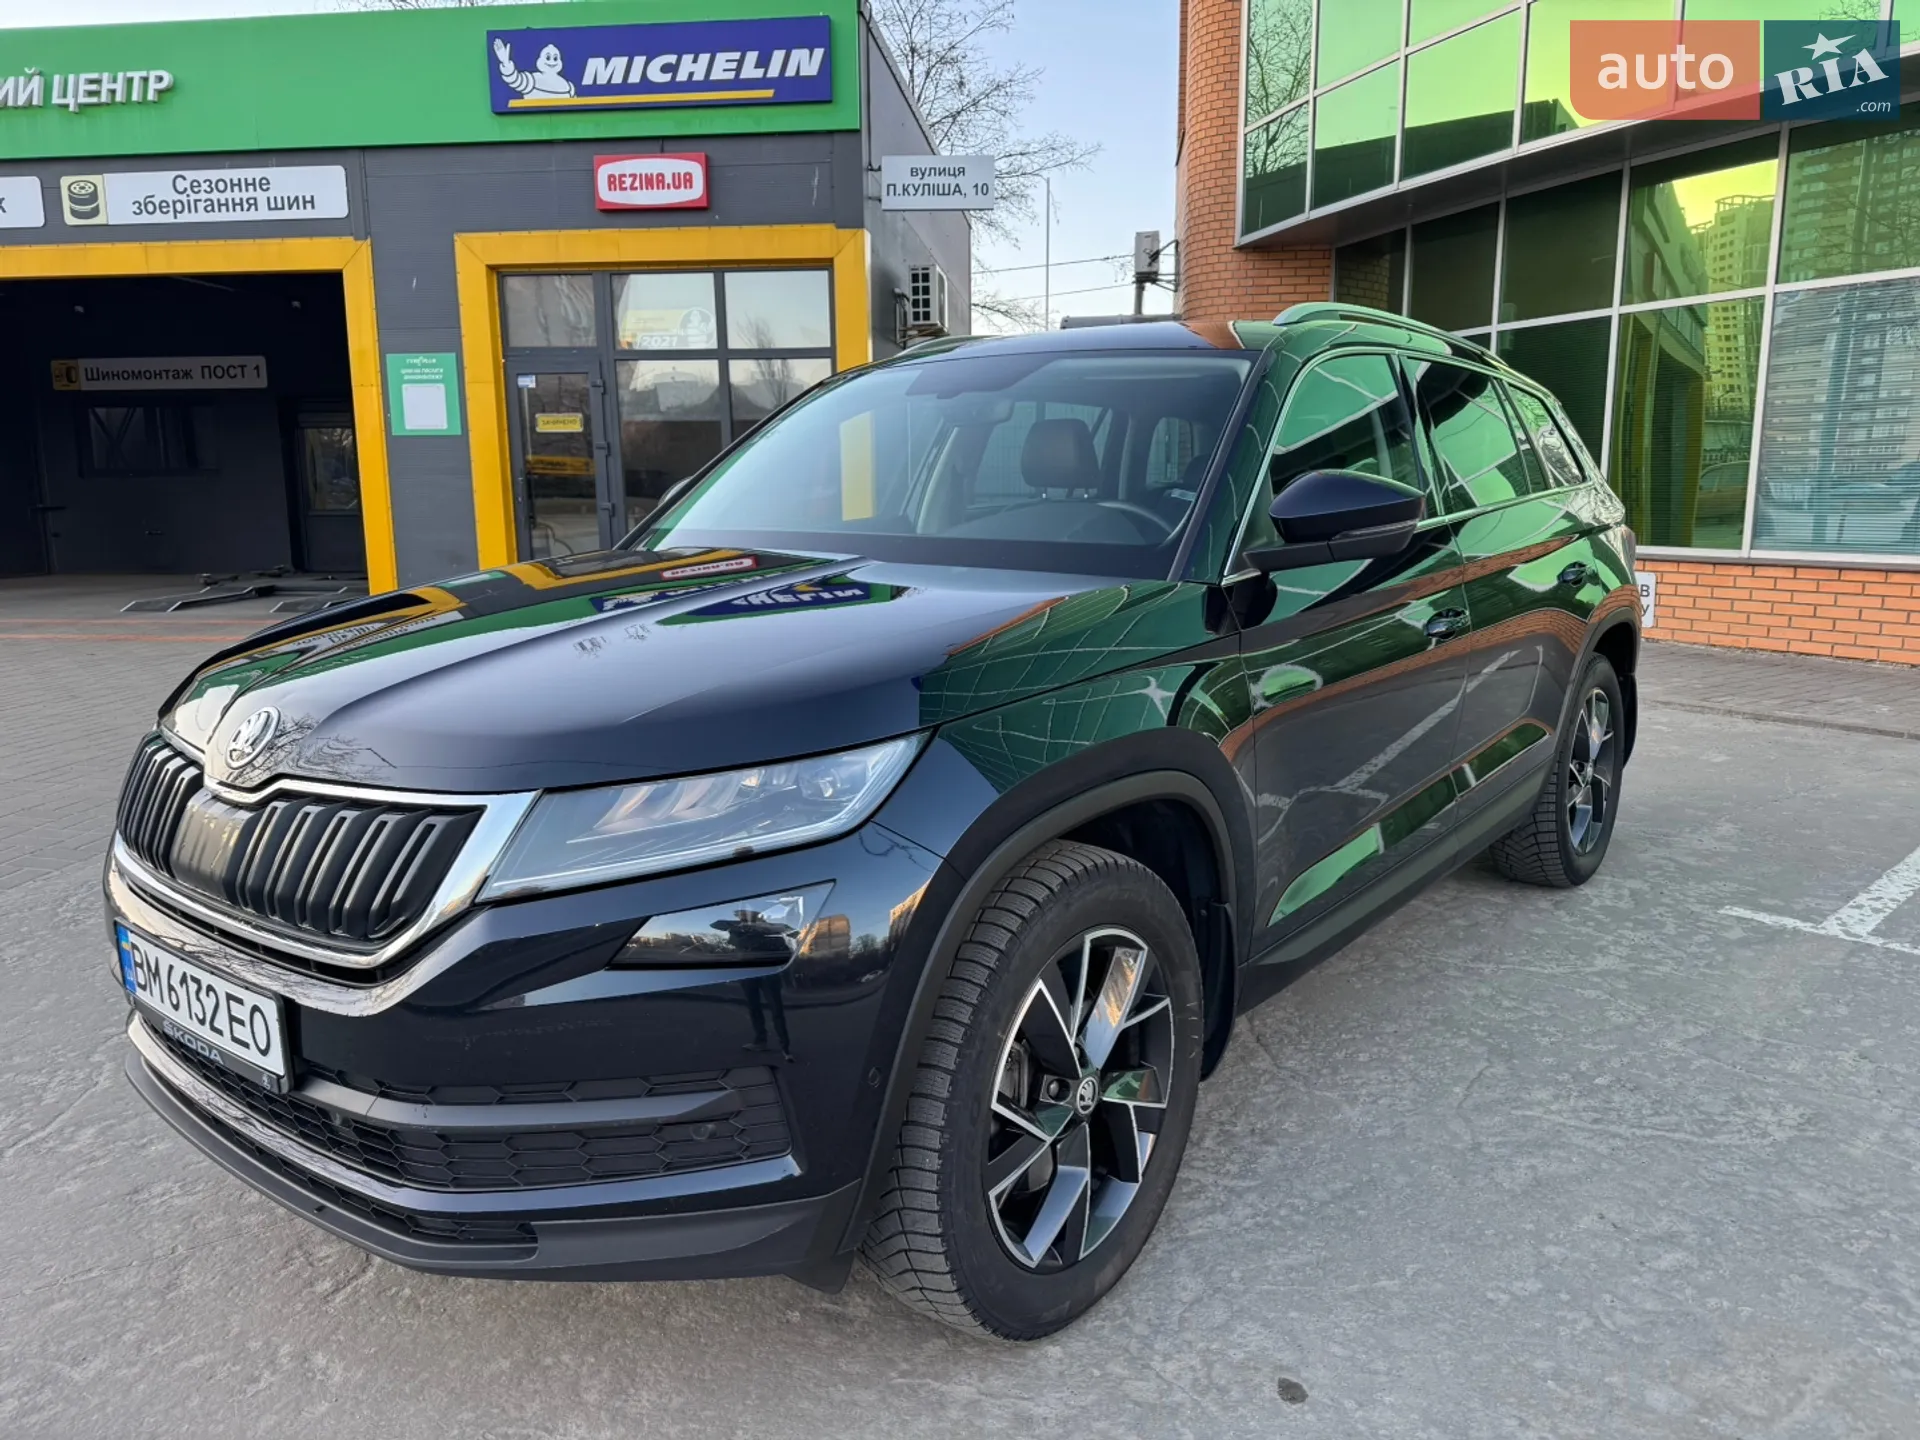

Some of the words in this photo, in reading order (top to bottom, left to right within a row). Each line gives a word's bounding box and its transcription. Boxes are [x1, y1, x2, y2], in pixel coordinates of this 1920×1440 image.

[581, 47, 825, 86] MICHELIN
[52, 69, 174, 113] ЦЕНТР
[607, 172, 694, 192] REZINA.UA
[910, 167, 966, 180] вулиця
[172, 174, 271, 195] Сезонне
[886, 183, 967, 198] П.КУЛІША,
[972, 182, 990, 196] 10
[131, 195, 260, 219] зберігання
[266, 195, 316, 212] шин
[84, 366, 193, 382] Шиномонтаж
[200, 364, 248, 380] ПОСТ
[253, 364, 261, 379] 1
